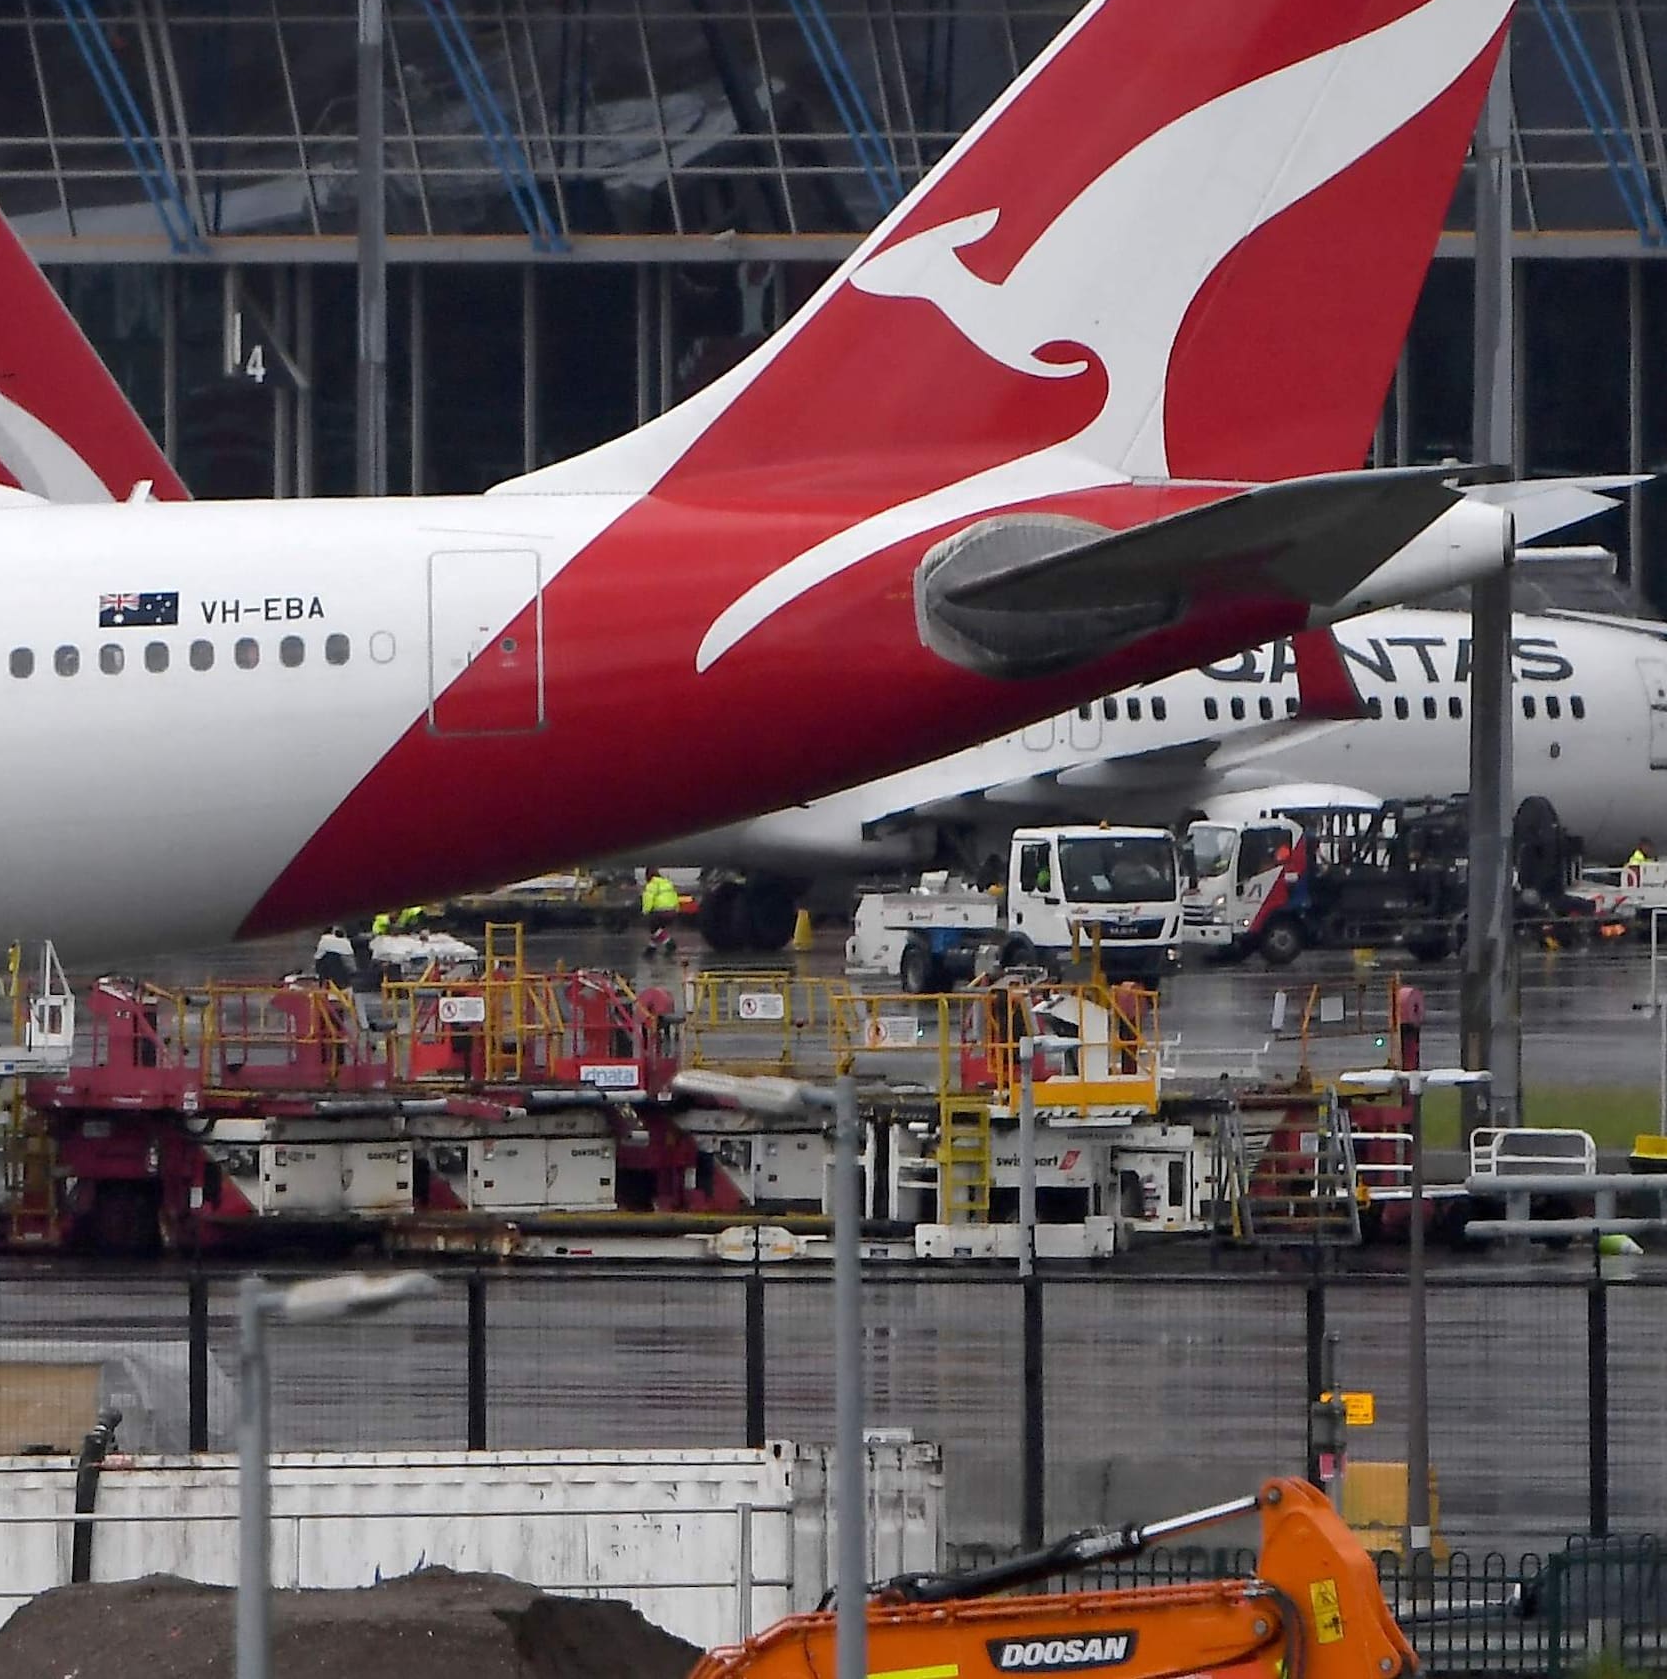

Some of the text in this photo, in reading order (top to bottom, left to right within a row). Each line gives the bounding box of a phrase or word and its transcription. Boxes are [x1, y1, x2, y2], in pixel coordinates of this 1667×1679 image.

[246, 344, 266, 383] 4
[200, 596, 325, 624] VH-EBA
[1000, 1636, 1129, 1668] DOOSAN
